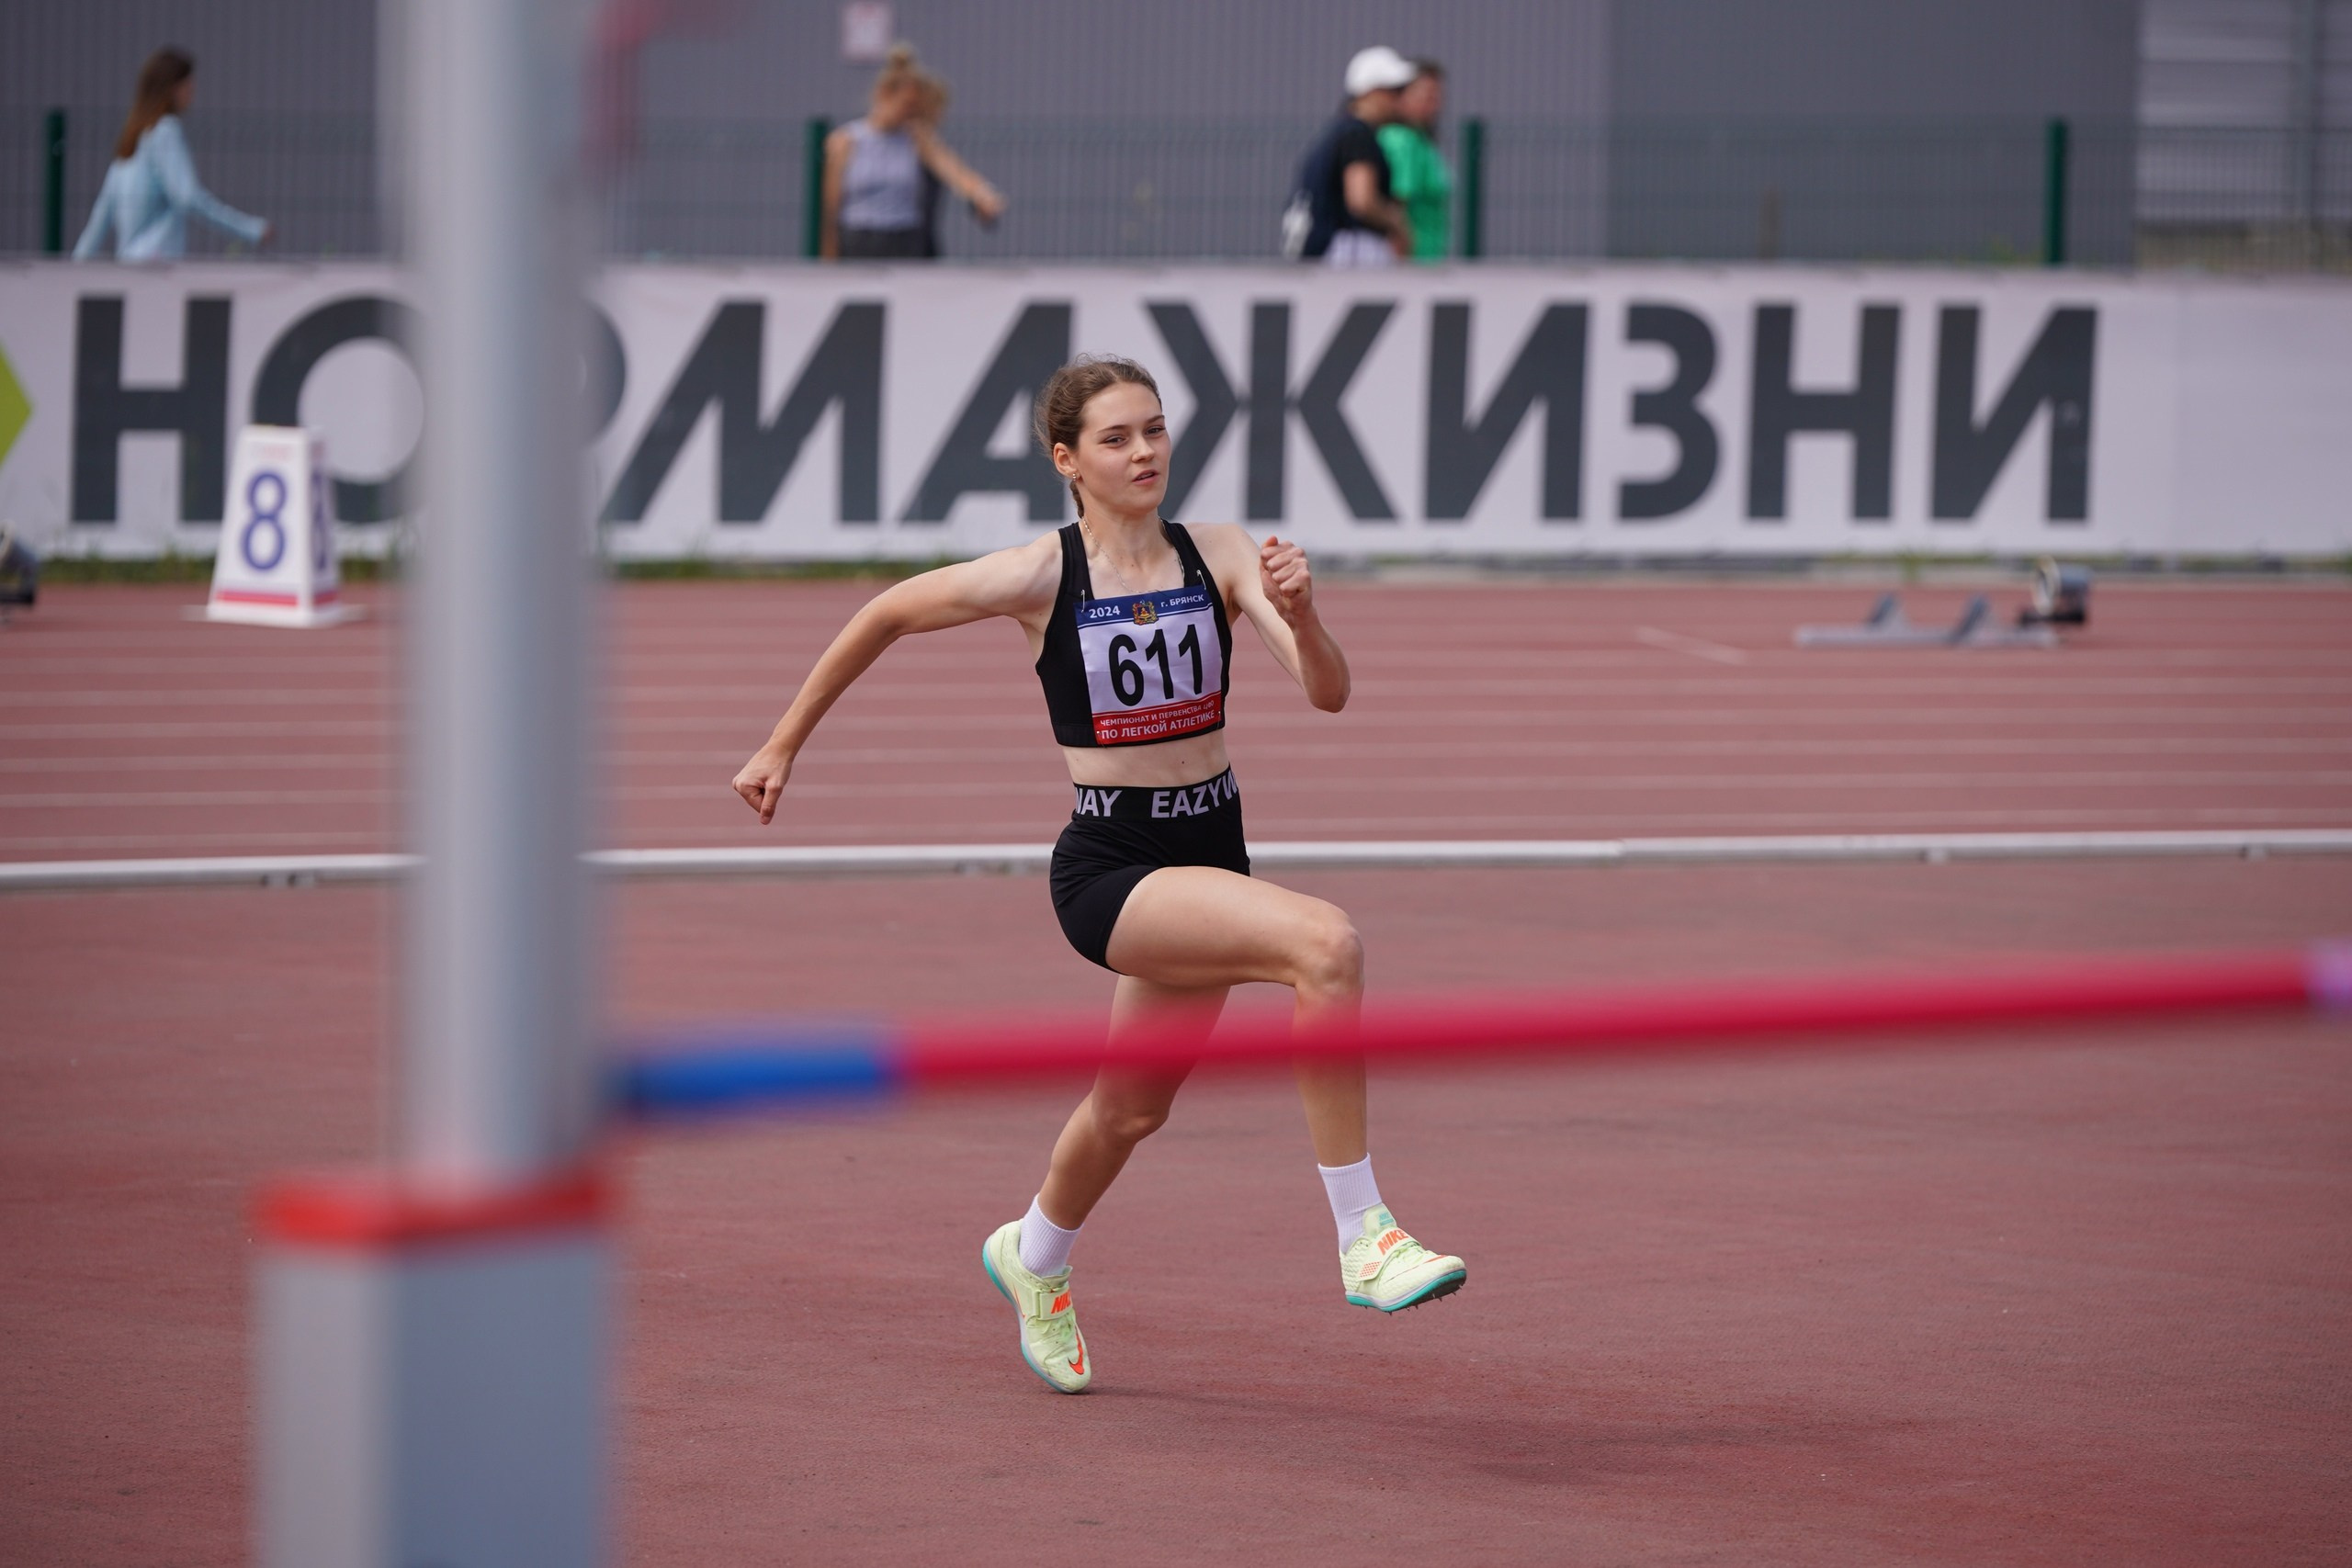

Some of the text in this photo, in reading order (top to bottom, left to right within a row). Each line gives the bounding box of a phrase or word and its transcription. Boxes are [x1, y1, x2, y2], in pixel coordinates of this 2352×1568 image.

[1145, 298, 2098, 523] ЖИЗНИ
[242, 471, 287, 571] 8
[1088, 605, 1121, 619] 2024
[1170, 593, 1204, 606] БРЯНСК
[1108, 624, 1204, 707] 611
[1100, 715, 1150, 727] ЧЕМПИОНАТ
[1151, 713, 1158, 721] И
[1159, 705, 1202, 719] ПЕРВЕНСТВА
[1102, 709, 1216, 739] ПО ЛЕГКОЙ АТЛЕТИКЕ
[1377, 1229, 1409, 1257] NIKE
